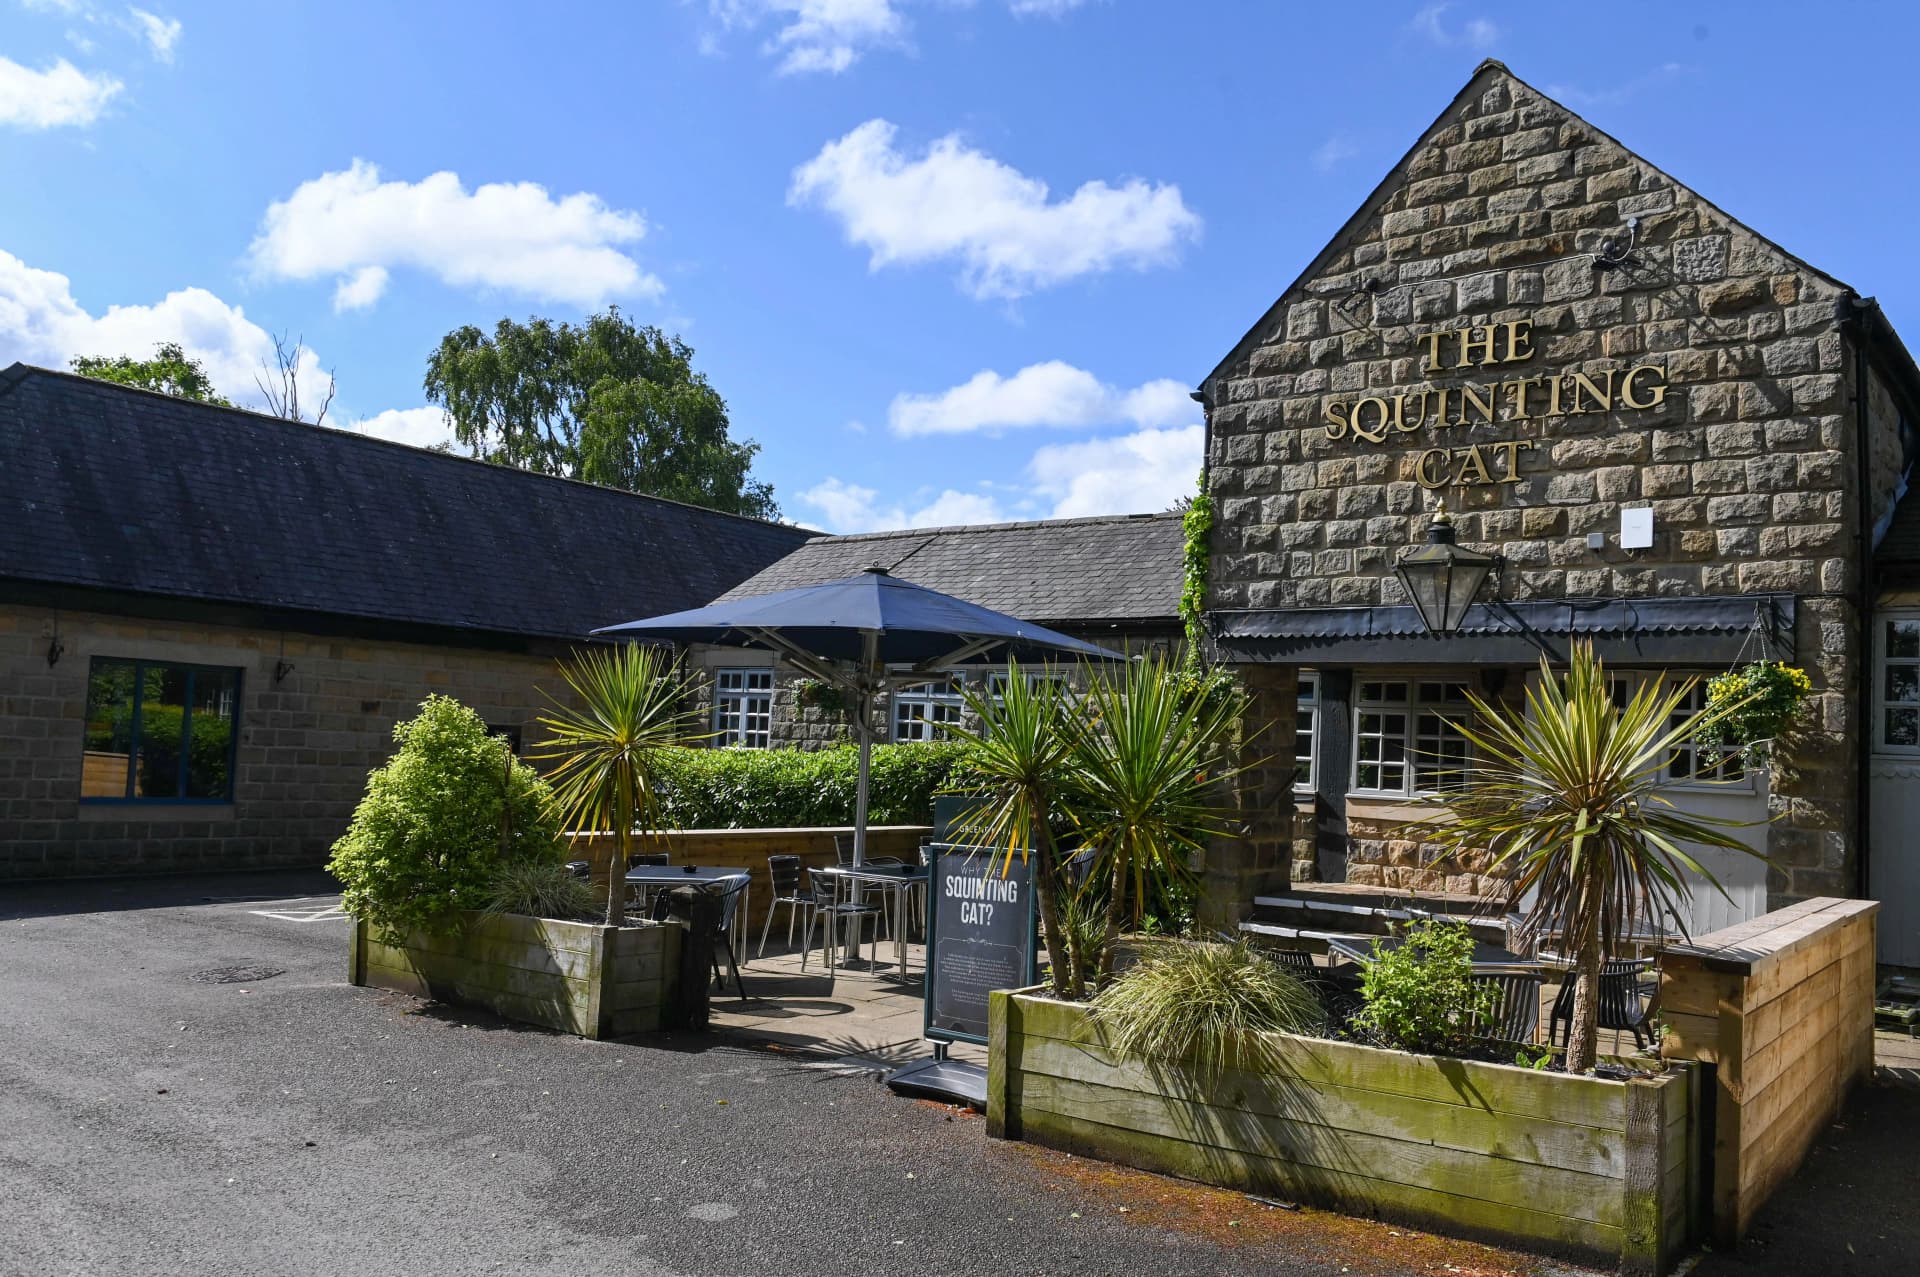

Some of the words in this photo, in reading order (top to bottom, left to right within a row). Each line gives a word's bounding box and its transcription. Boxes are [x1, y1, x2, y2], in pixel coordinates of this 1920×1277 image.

[1417, 318, 1535, 372] THE
[1325, 365, 1669, 443] SQUINTING
[1416, 439, 1533, 489] CAT
[945, 875, 1018, 904] SQUINTING
[961, 866, 980, 875] WHY
[961, 901, 994, 927] CAT?
